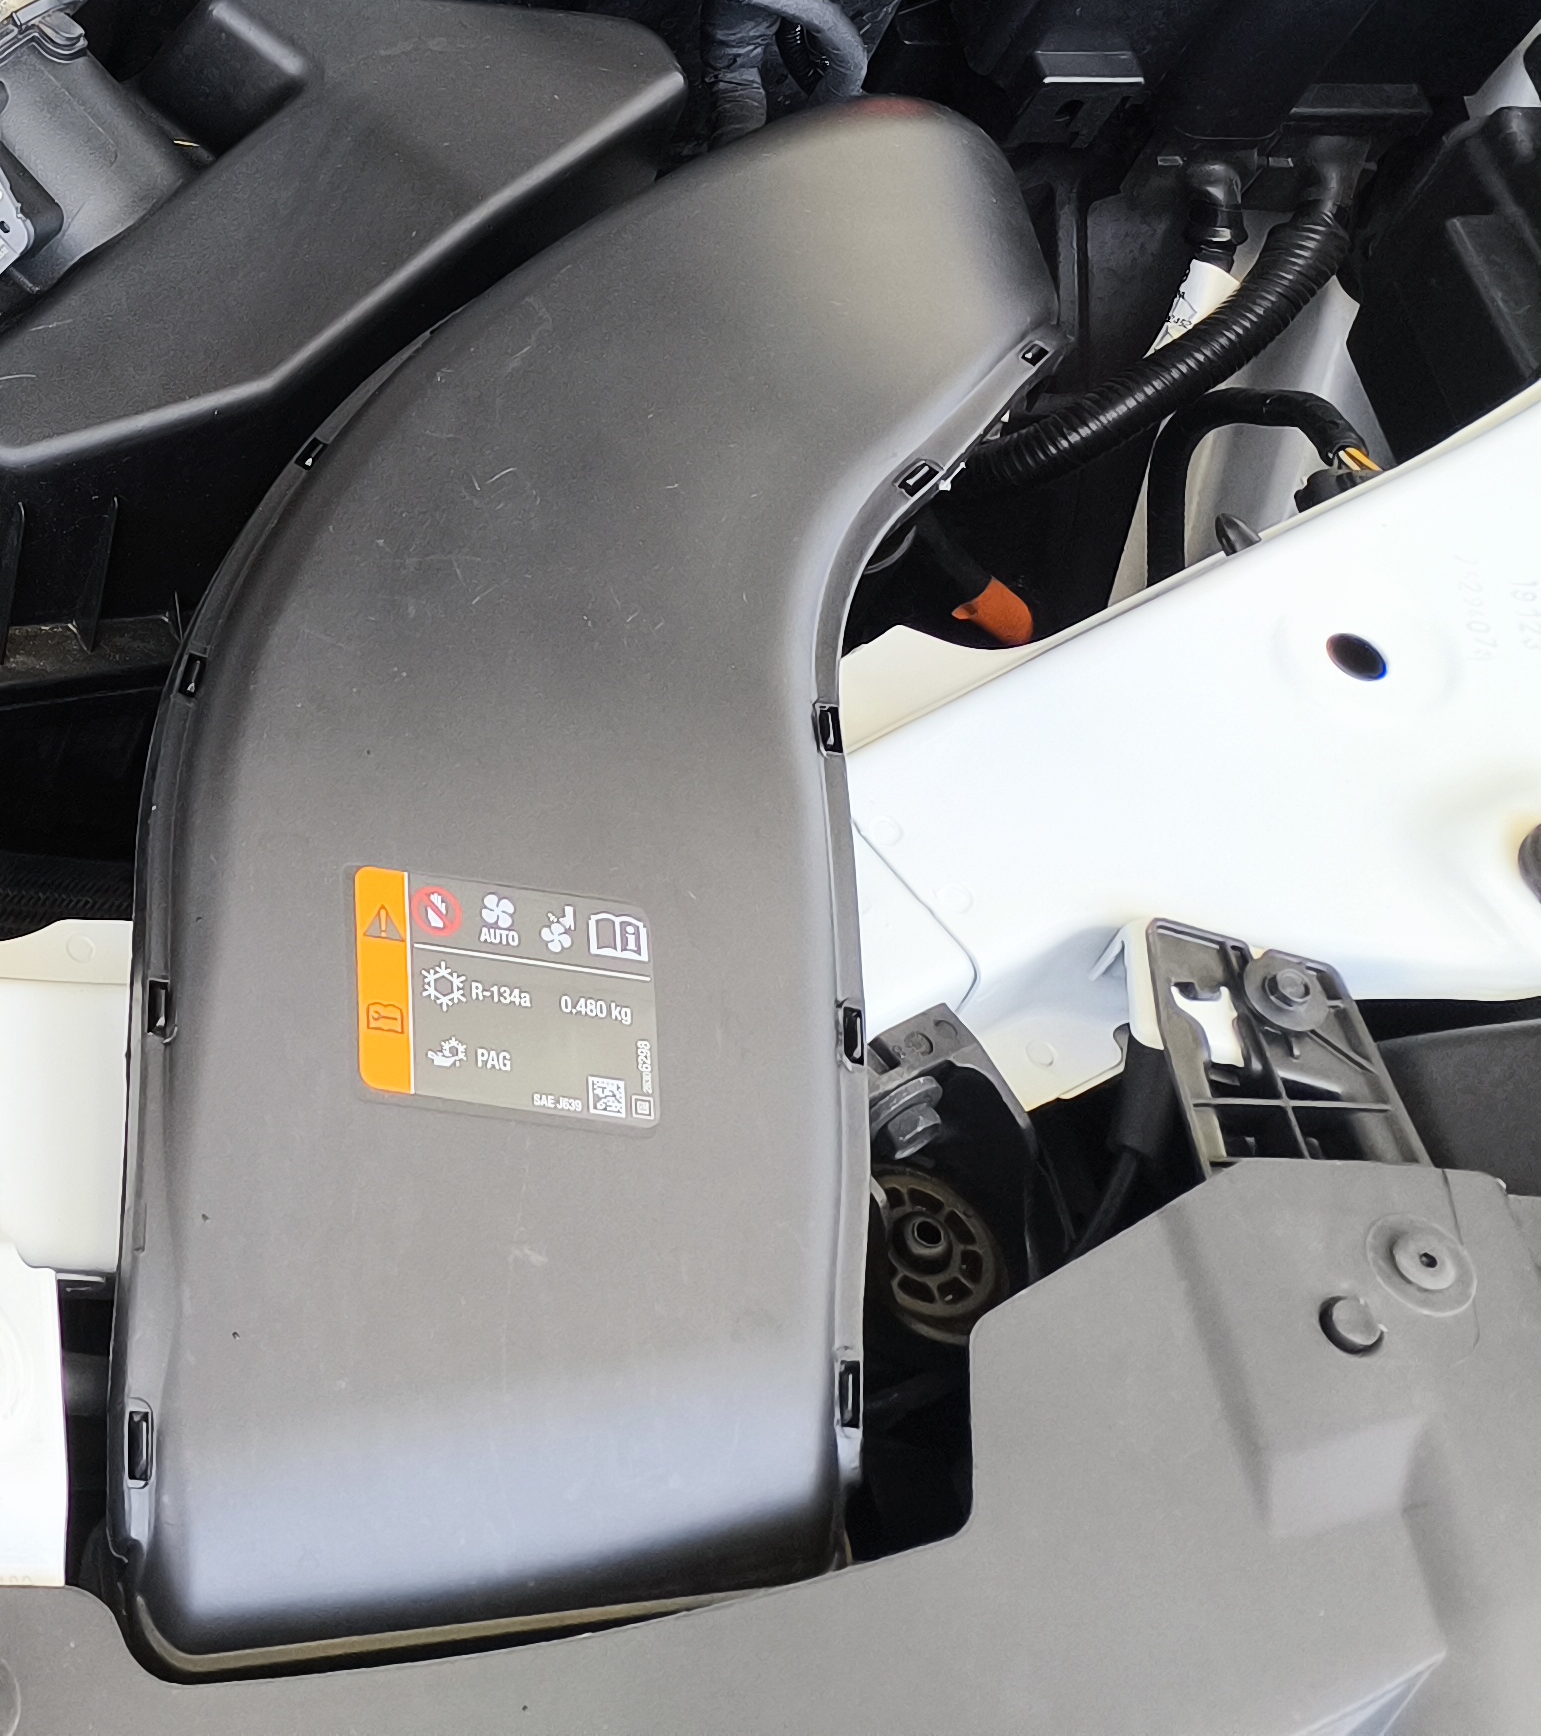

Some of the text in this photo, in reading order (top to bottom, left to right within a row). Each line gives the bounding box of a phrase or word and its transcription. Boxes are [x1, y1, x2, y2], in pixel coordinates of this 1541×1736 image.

[479, 927, 519, 947] AUTO
[471, 982, 532, 1008] R-134a
[611, 1002, 632, 1025] kg
[477, 1048, 512, 1071] PAG
[533, 1093, 582, 1112] SAE J639
